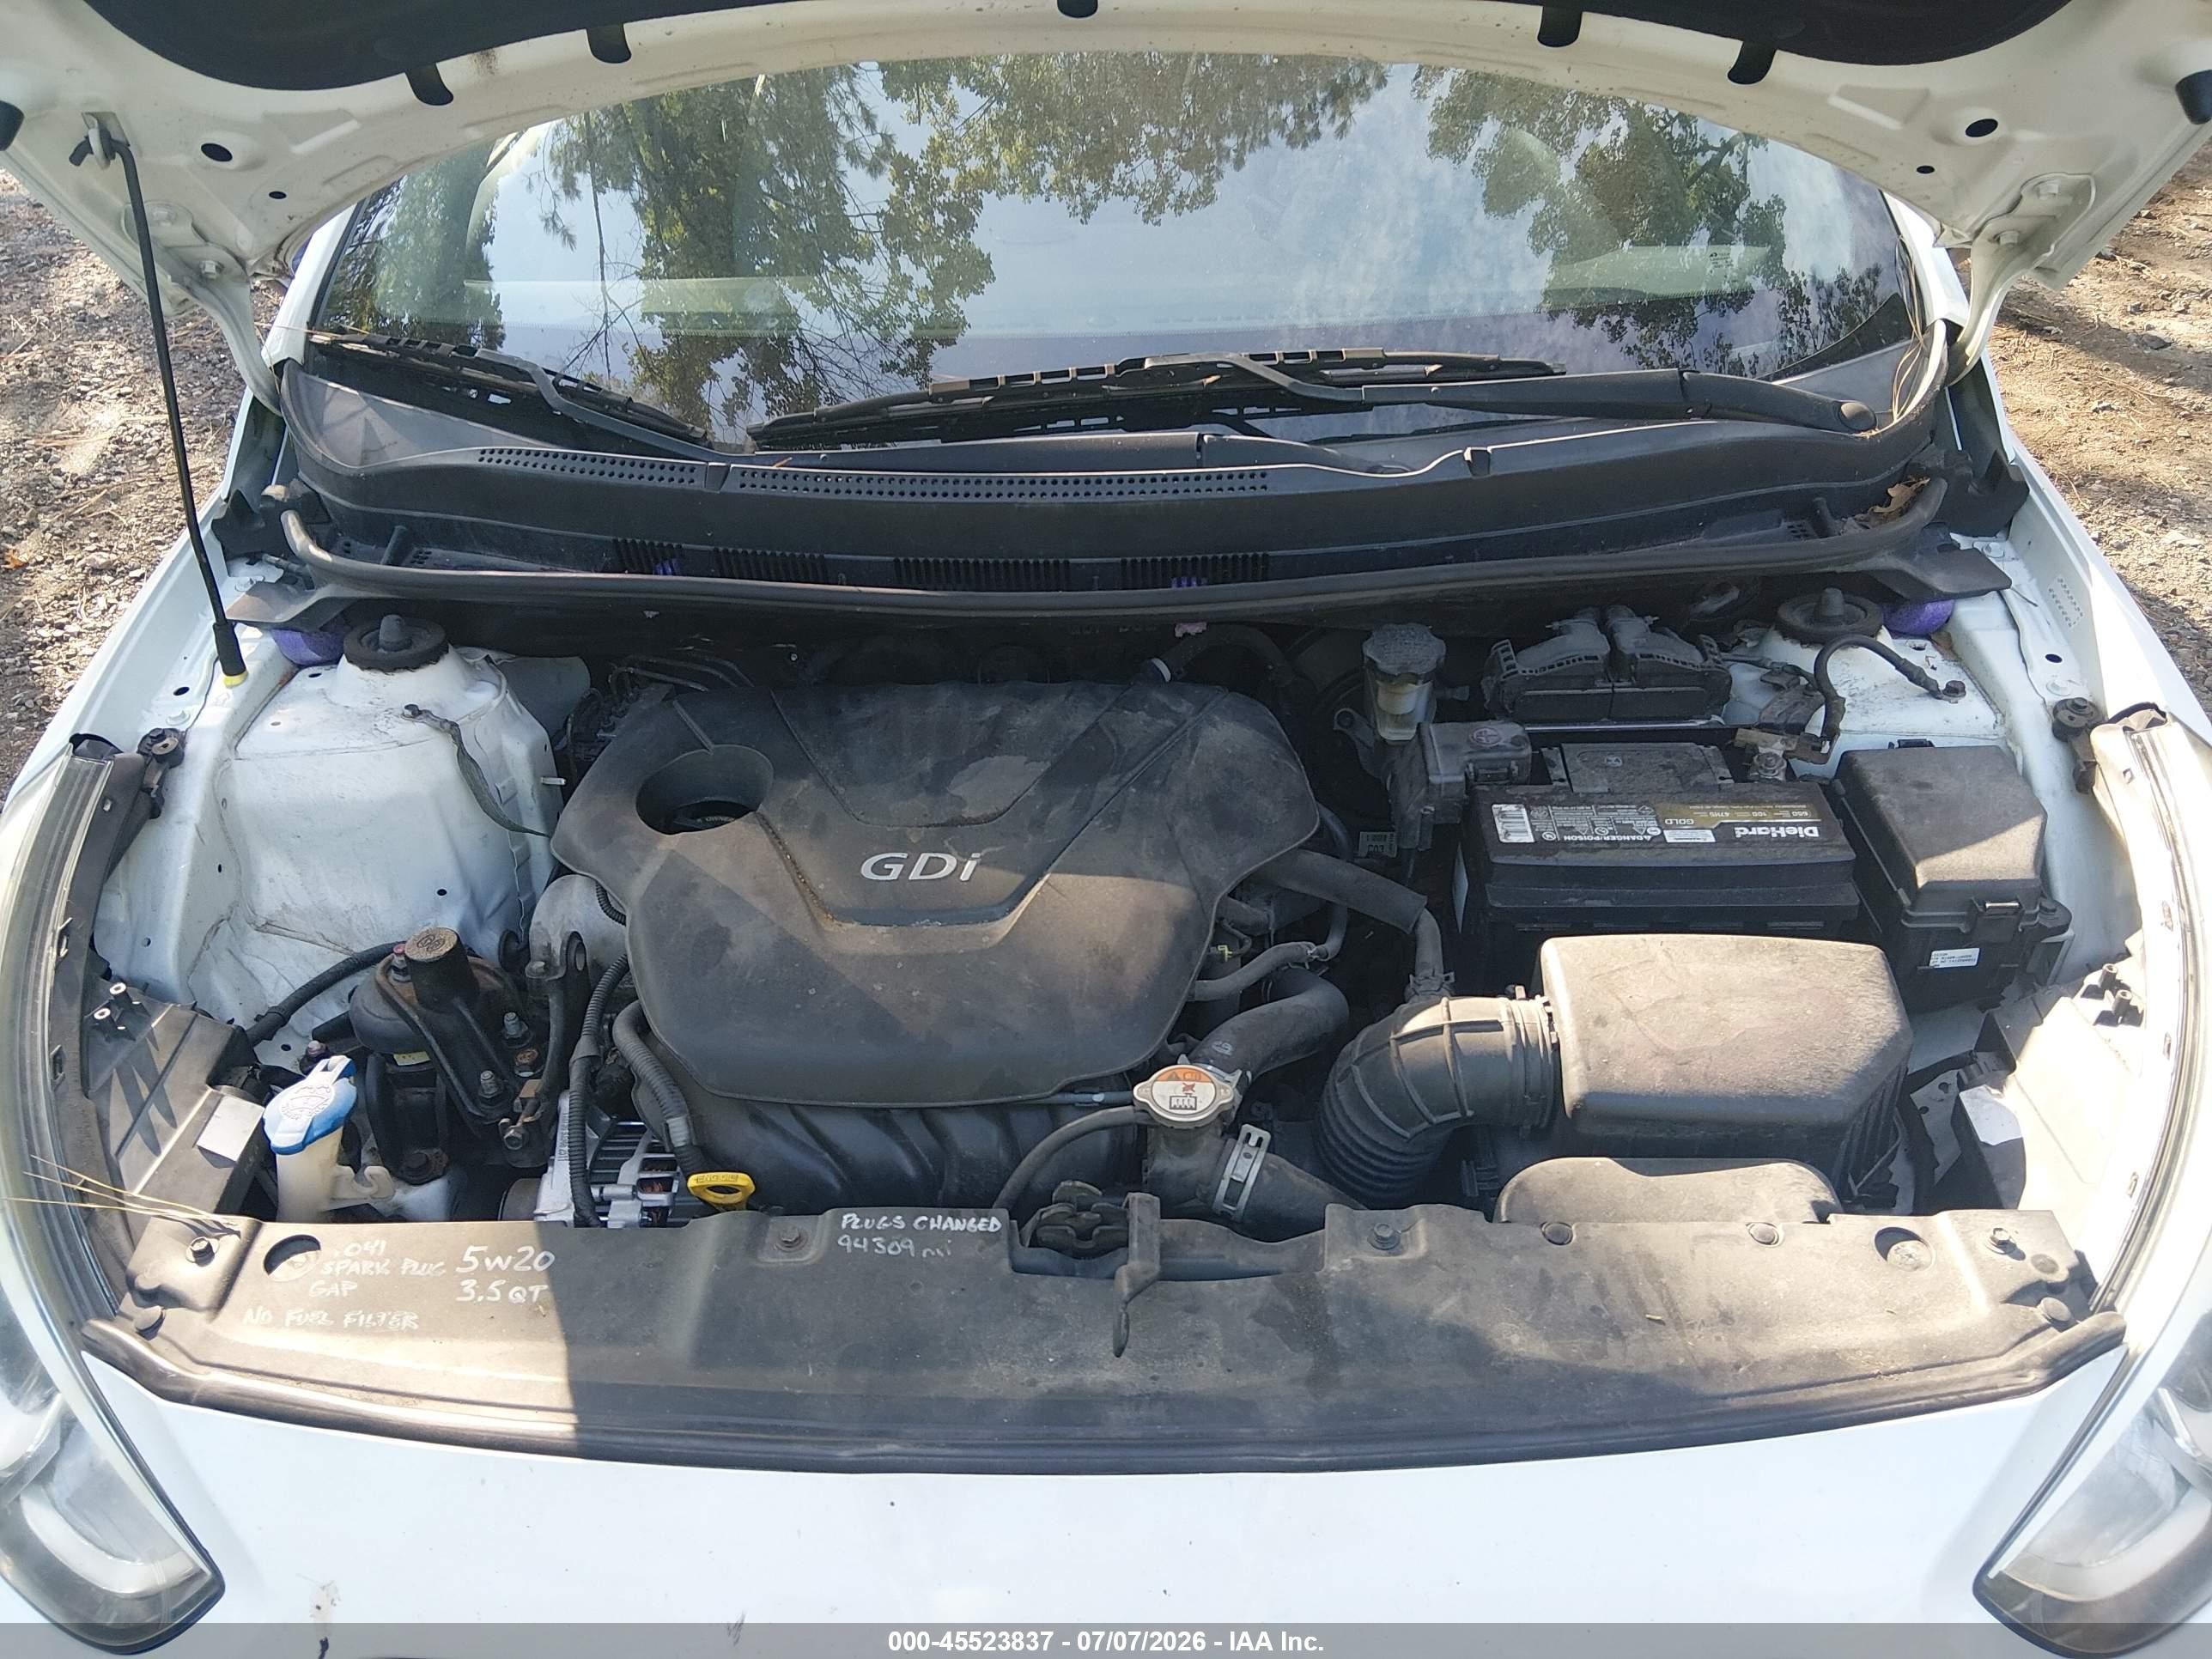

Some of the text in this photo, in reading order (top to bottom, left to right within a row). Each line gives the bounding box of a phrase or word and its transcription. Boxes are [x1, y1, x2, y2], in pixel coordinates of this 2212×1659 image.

[1735, 826, 1820, 838] DieHard
[860, 852, 981, 881] GDi
[841, 1212, 1002, 1233] PLUGS CHANGED
[320, 1259, 390, 1275] SPARK
[309, 1280, 358, 1297] GAP
[242, 1305, 273, 1325] NO
